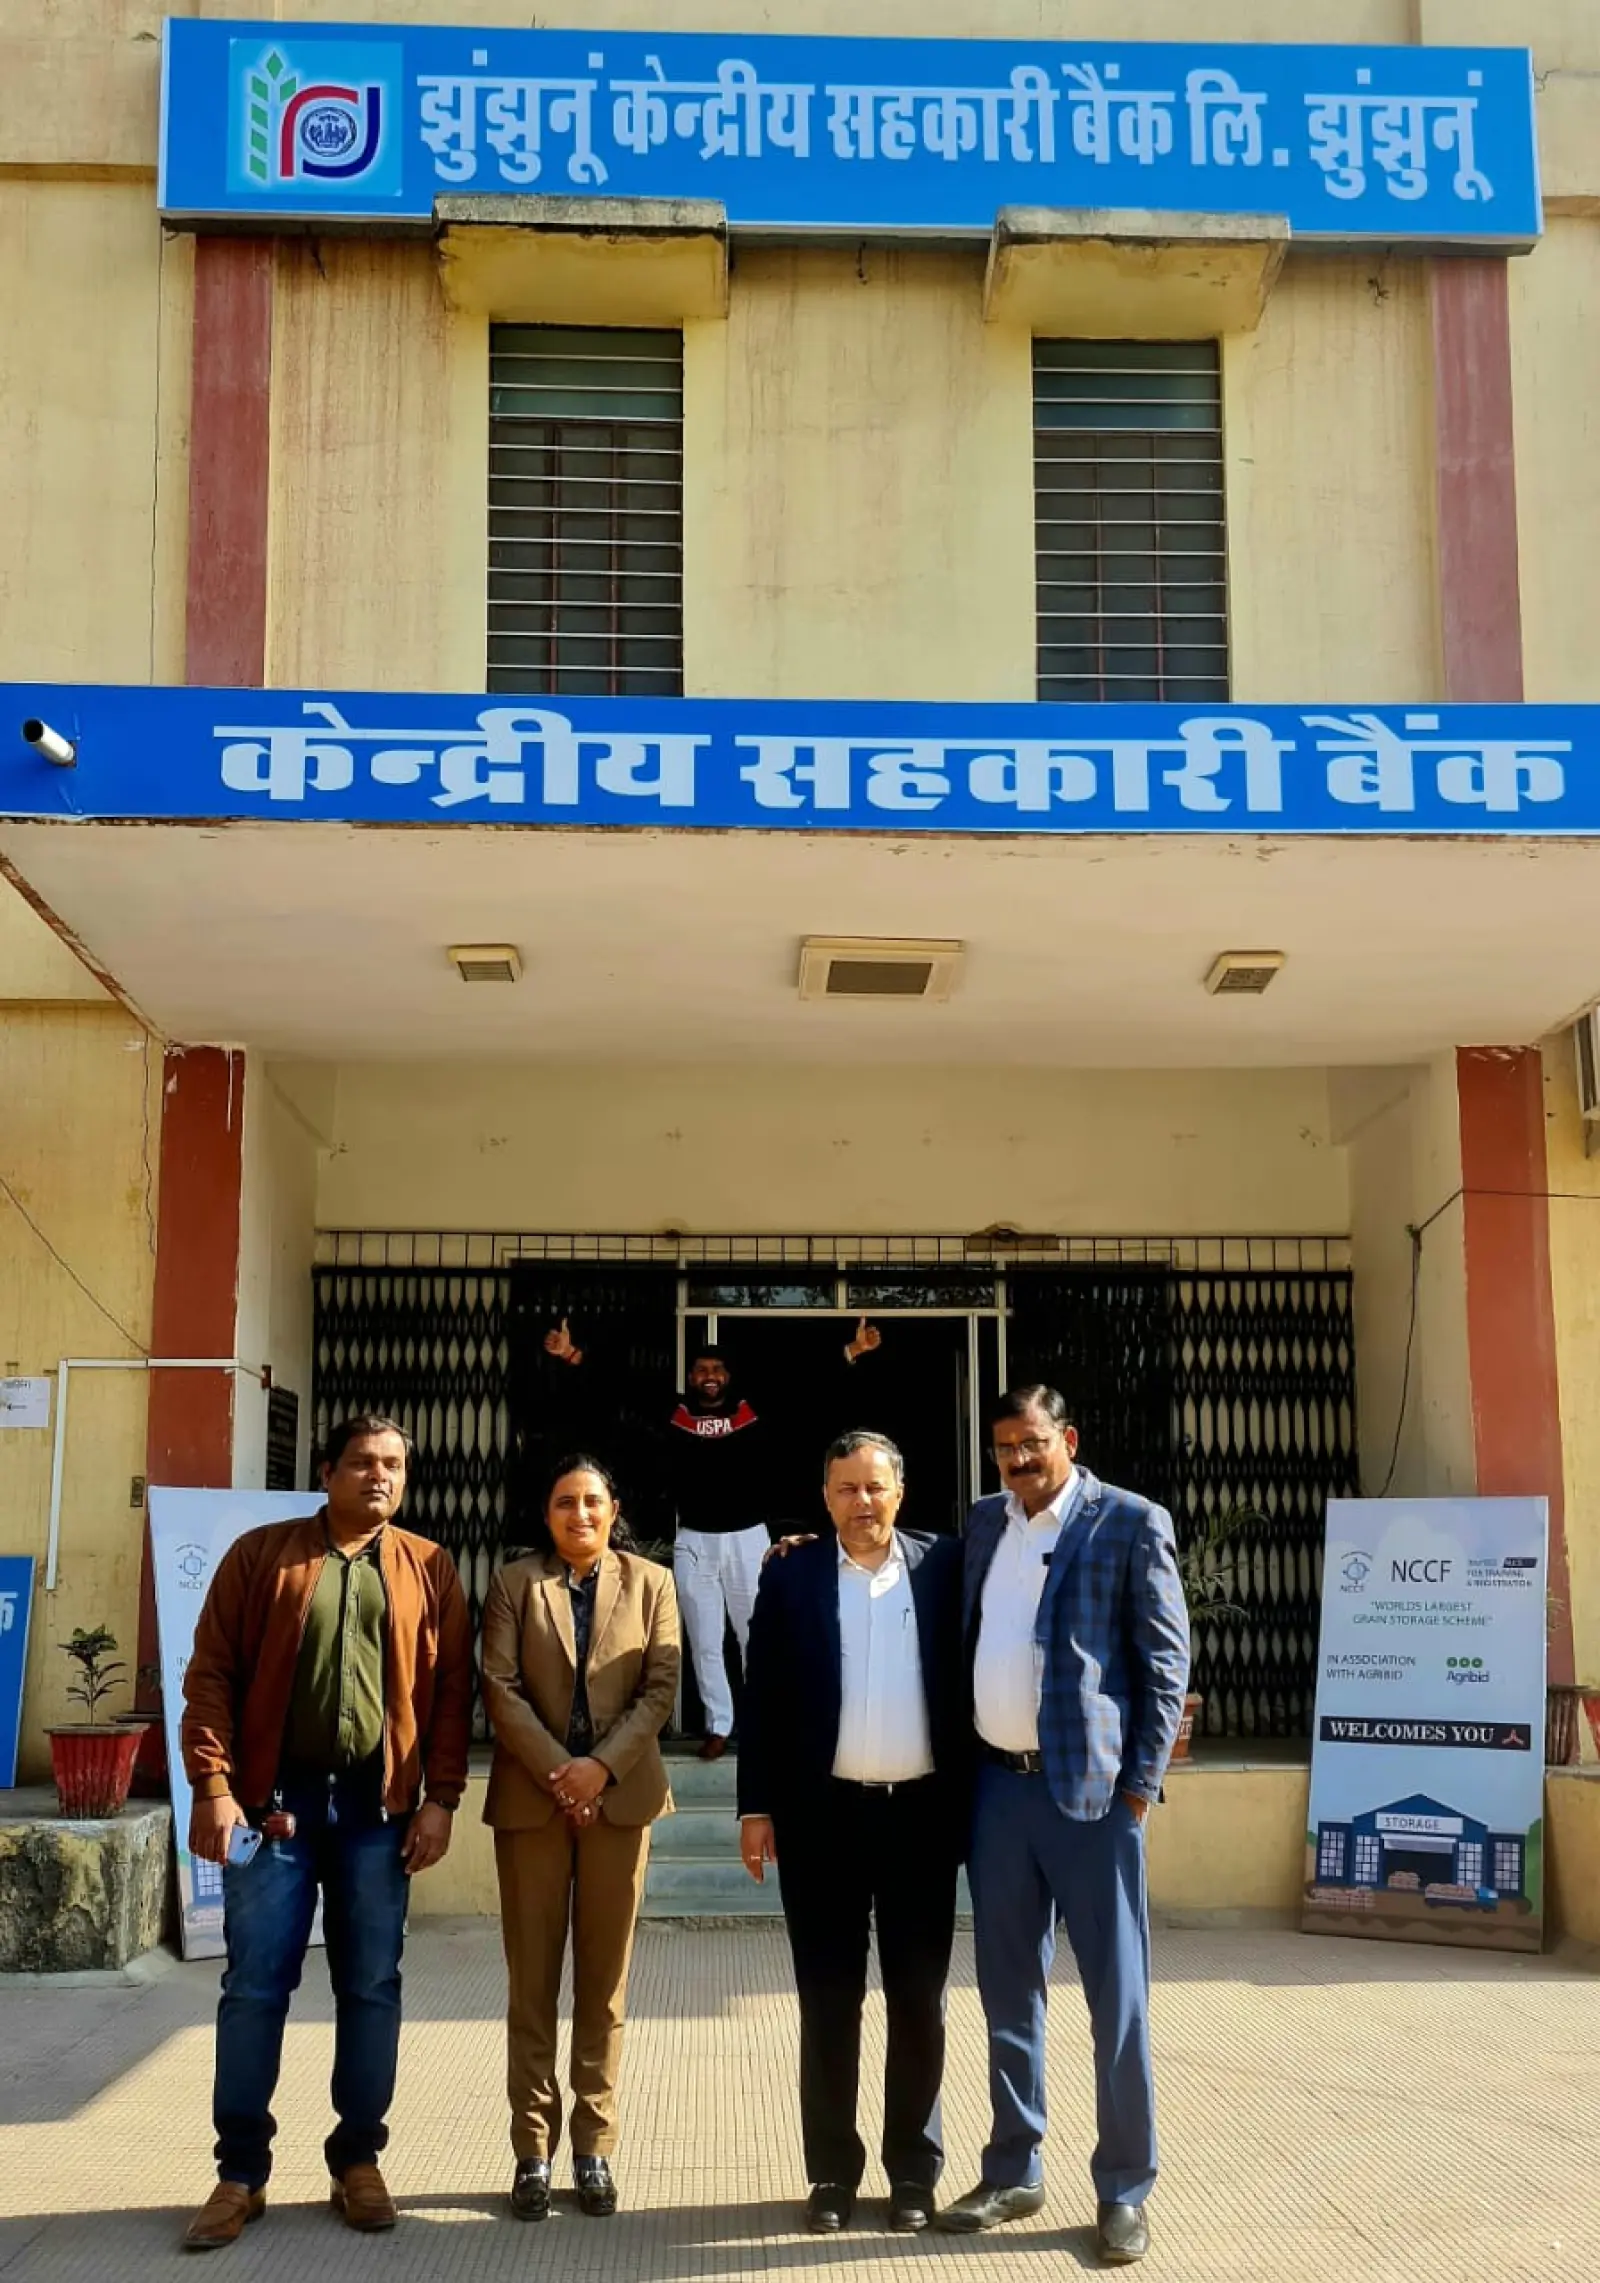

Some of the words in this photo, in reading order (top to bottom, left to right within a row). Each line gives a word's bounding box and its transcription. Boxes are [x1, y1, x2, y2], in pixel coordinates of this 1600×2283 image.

[417, 49, 608, 185] झुंझुनूं
[609, 55, 815, 160] केन्द्रीय
[825, 65, 1060, 163] सहकारी
[1060, 62, 1175, 165] बैंक
[1186, 69, 1290, 167] लि.
[1304, 68, 1493, 202] झुंझुनूं
[213, 702, 712, 808] केन्द्रीय
[735, 716, 1296, 813] सहकारी
[1300, 713, 1572, 813] बैंक
[697, 1418, 733, 1435] USPA
[1391, 1560, 1452, 1583] NCCF
[1424, 1602, 1473, 1612] LARGEST
[1353, 1614, 1386, 1625] GRAIN
[1389, 1615, 1440, 1626] STORAGE
[1327, 1655, 1338, 1665] IN
[1341, 1655, 1416, 1667] ASSOCIATION
[1326, 1669, 1354, 1679] WITH
[1358, 1670, 1403, 1681] AGRIBID
[1446, 1670, 1490, 1685] Agribid
[1330, 1720, 1446, 1741] WELCOMES
[1452, 1726, 1495, 1743] YOU
[1384, 1817, 1441, 1830] STORAGE
